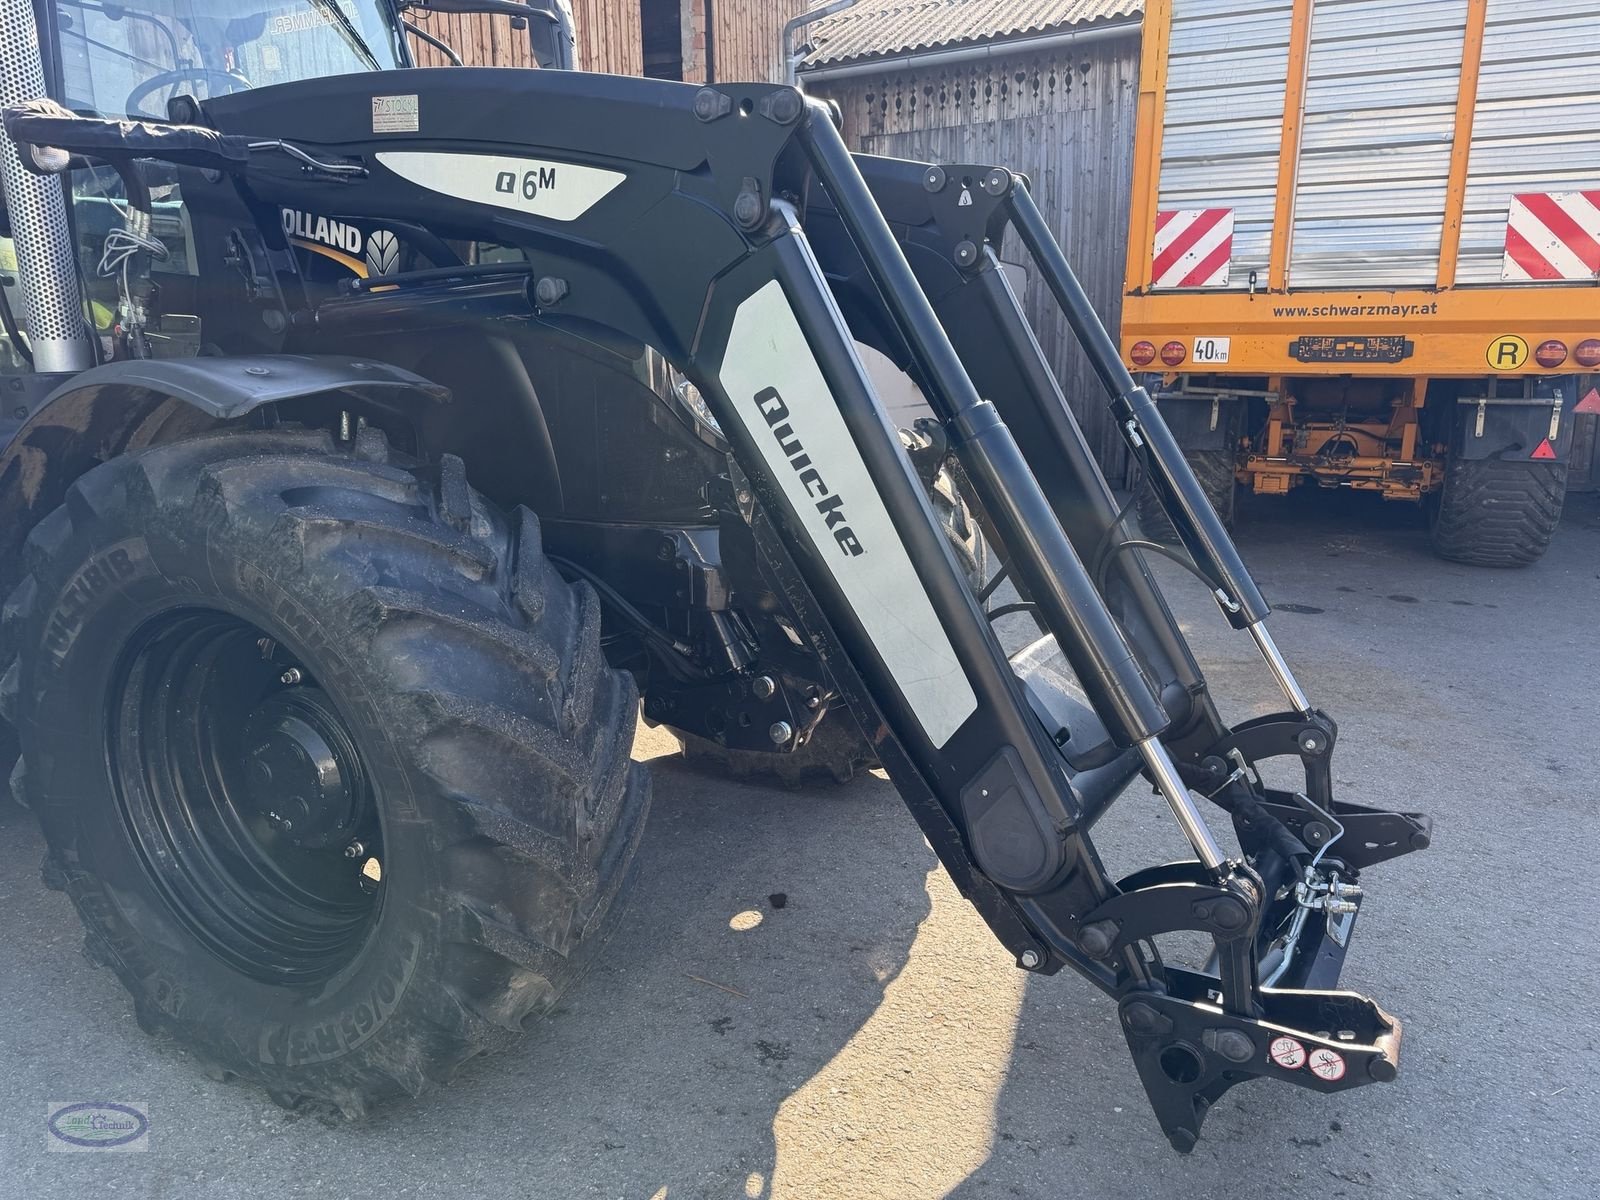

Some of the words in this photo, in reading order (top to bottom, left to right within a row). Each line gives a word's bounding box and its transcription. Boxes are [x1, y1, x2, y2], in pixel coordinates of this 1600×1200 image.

[1273, 302, 1437, 317] www.schwarzmayr.at
[1497, 342, 1519, 365] R
[753, 385, 864, 558] Quicke
[46, 546, 136, 664] ULTIBIB
